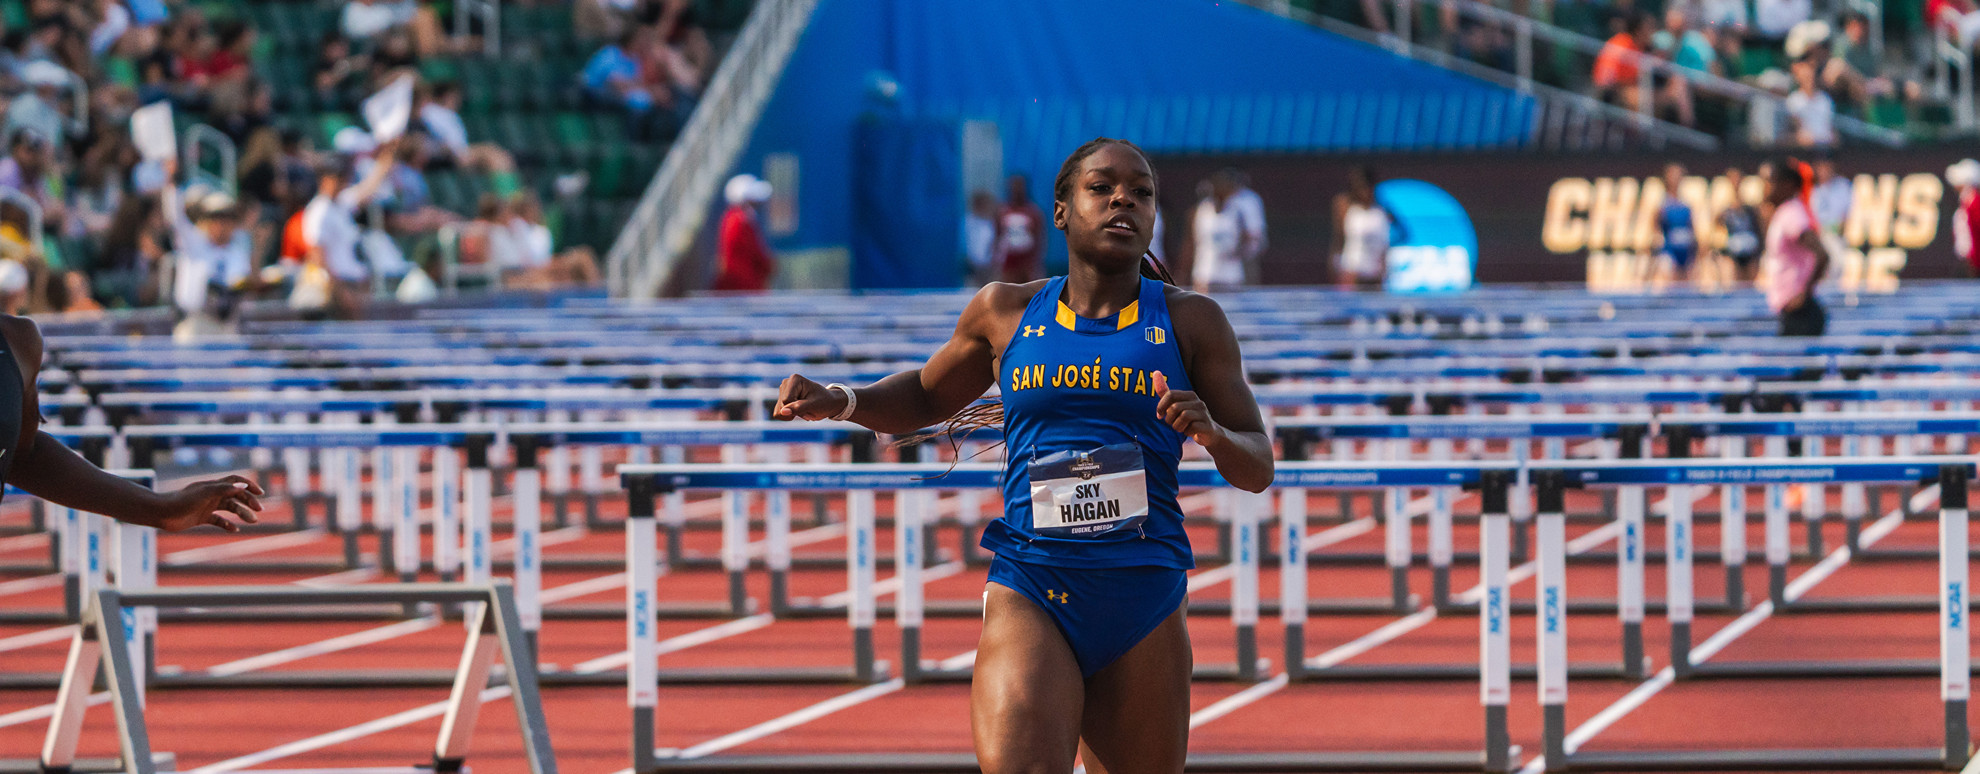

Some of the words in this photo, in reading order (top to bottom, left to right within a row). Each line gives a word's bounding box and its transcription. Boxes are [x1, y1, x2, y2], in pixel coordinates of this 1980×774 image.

[1012, 364, 1046, 392] SAN
[1051, 355, 1102, 389] JOSÉ
[1109, 366, 1168, 398] STAT
[1075, 483, 1100, 499] SKY
[1060, 499, 1120, 523] HAGAN
[1071, 526, 1092, 534] EUGENE,
[1093, 523, 1114, 532] OREGON
[1948, 581, 1962, 629] NCAA
